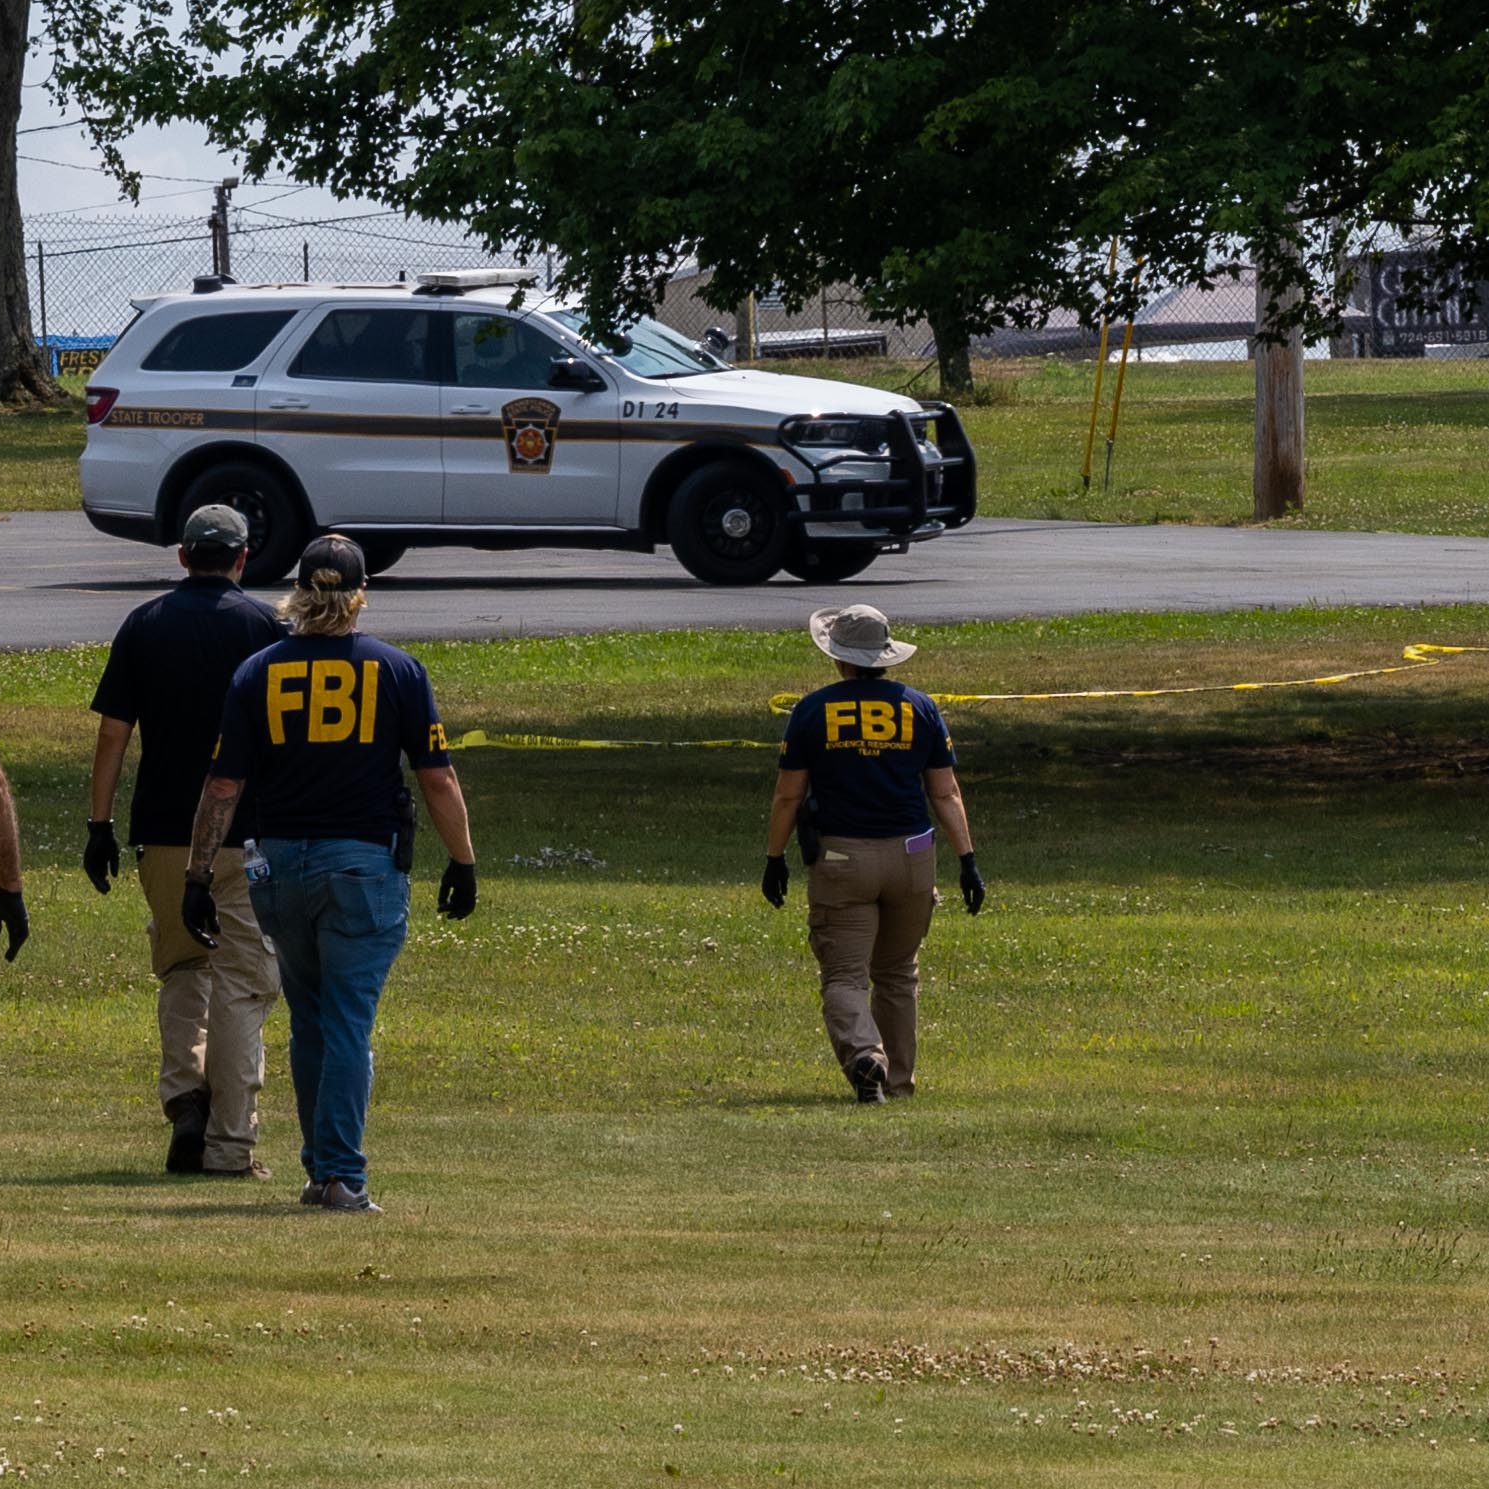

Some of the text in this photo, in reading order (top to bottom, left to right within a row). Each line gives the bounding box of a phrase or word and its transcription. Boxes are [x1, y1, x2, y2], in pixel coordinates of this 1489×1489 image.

[110, 410, 205, 425] STATE TROOPER
[654, 401, 679, 419] 24
[266, 658, 381, 746] FBI
[824, 700, 916, 743] FBI
[825, 740, 913, 752] EVIDENCE RESPONSE
[857, 748, 881, 758] TEAM
